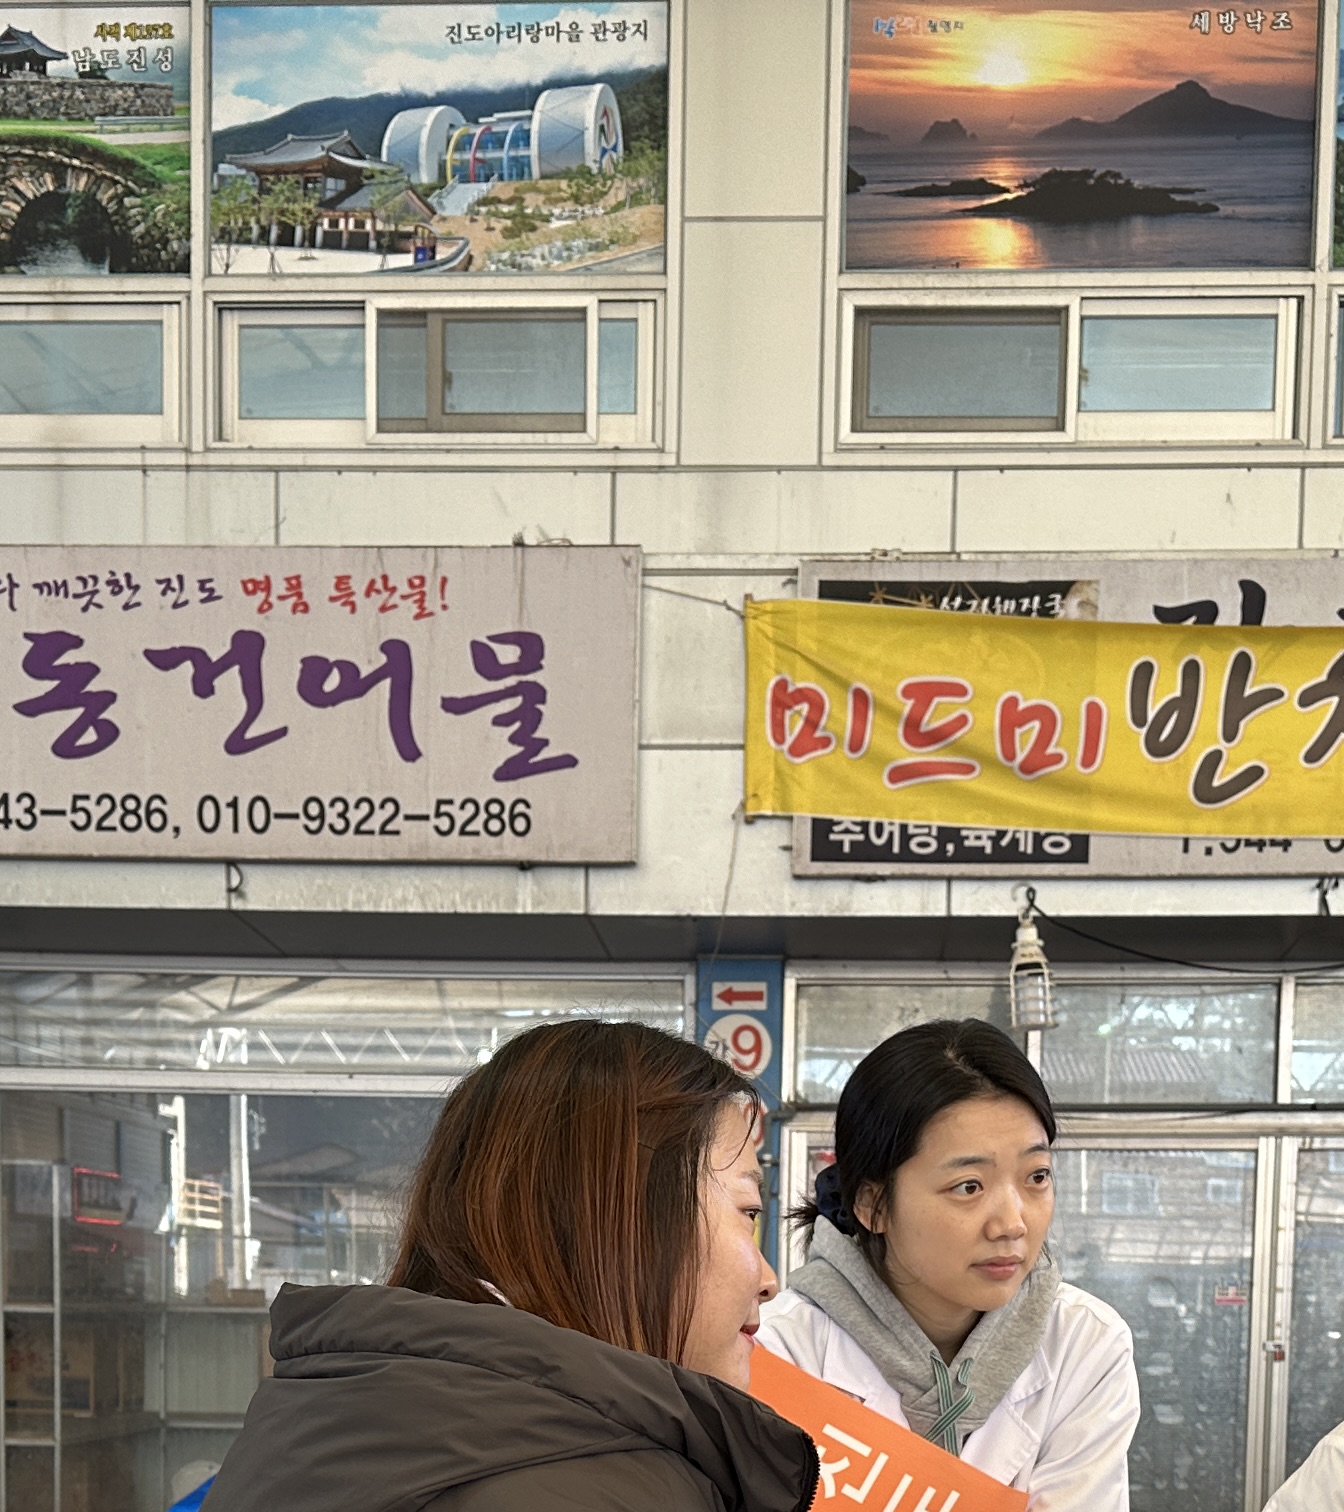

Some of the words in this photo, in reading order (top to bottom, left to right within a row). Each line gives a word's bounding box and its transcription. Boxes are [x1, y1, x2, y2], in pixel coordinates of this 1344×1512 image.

[445, 21, 584, 45] 진도아리랑마을
[589, 19, 649, 42] 관광지
[33, 569, 143, 614] 깨끗한
[156, 573, 224, 610] 진도
[241, 574, 311, 614] 명품
[328, 573, 450, 620] 특산물!
[196, 793, 533, 838] 010-9322-5286
